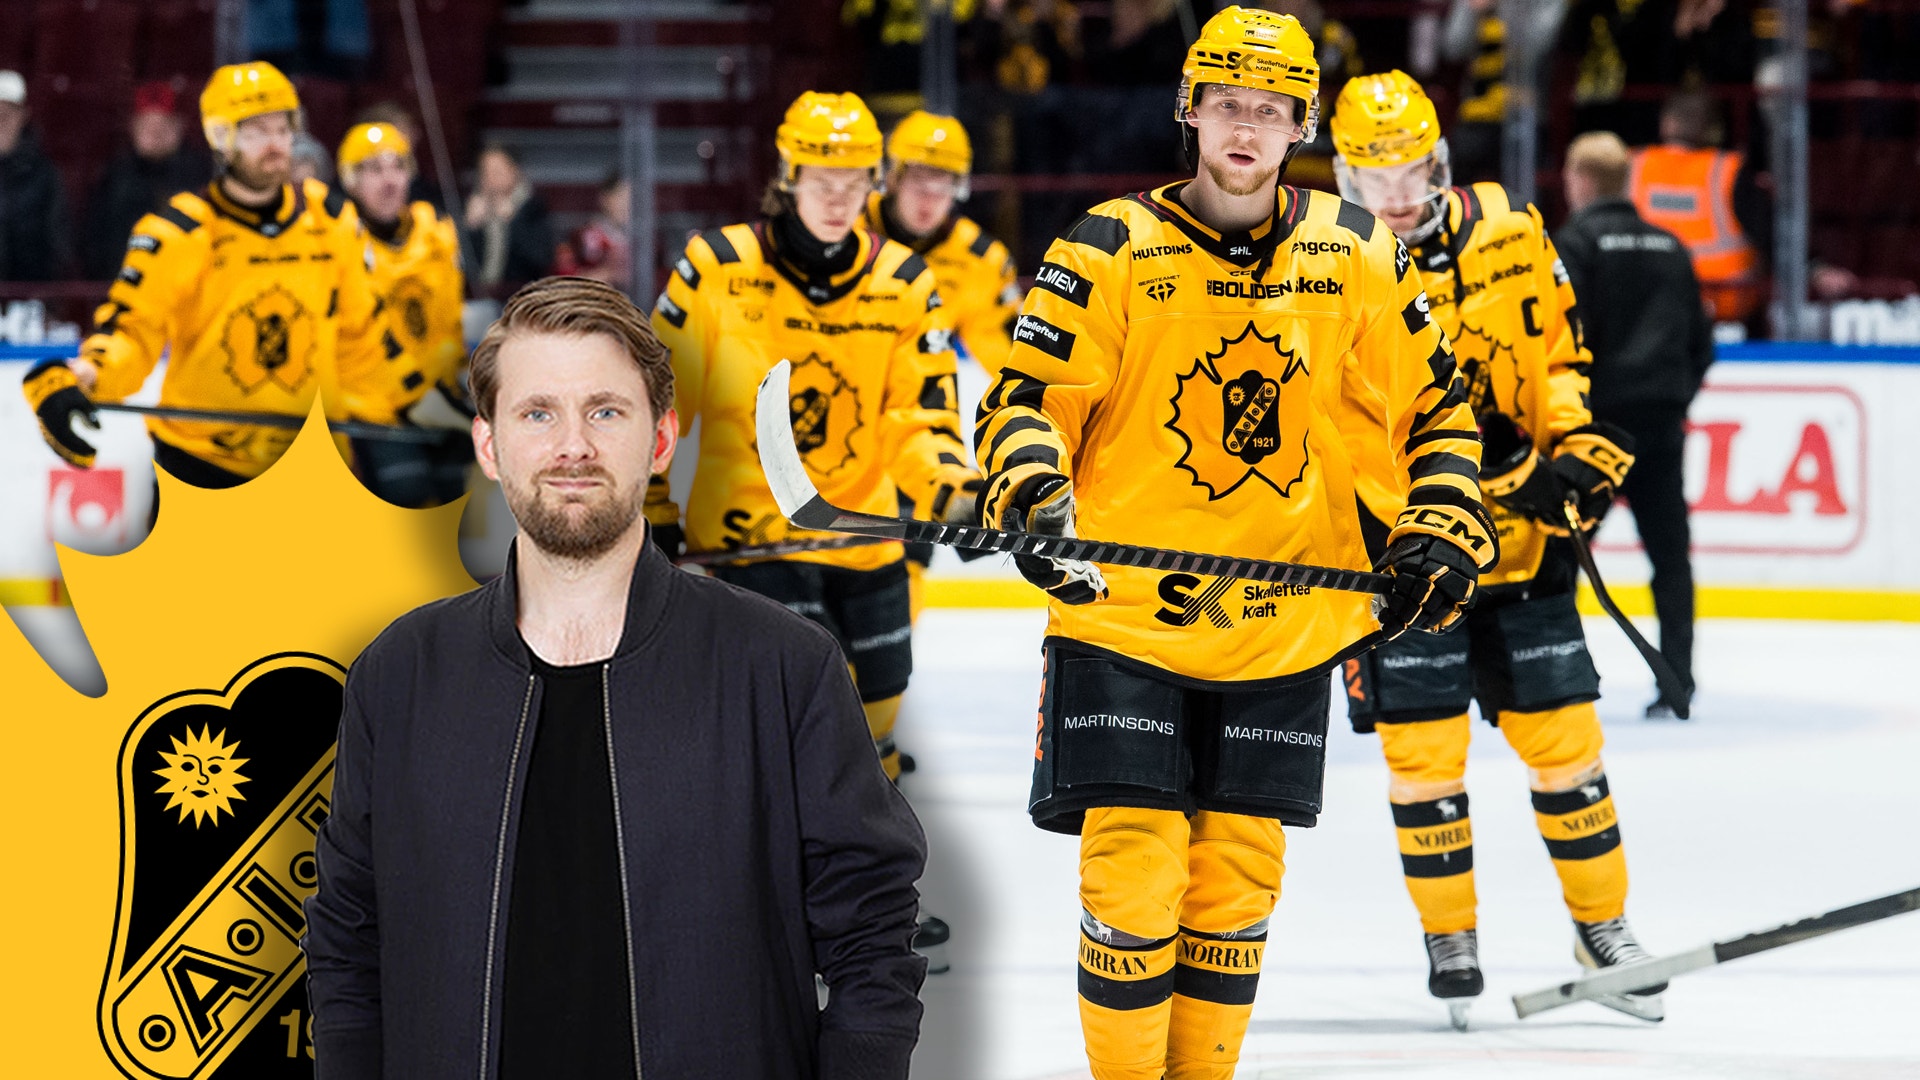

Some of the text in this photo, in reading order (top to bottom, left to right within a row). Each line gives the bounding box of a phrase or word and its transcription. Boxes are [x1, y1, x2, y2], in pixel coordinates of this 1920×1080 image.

[1132, 243, 1193, 261] HULTDINS
[1229, 246, 1252, 256] SHL
[1138, 274, 1181, 287] BERGTEAMET
[1212, 280, 1294, 300] BOLIDEN
[1521, 295, 1544, 337] C
[1252, 436, 1274, 448] 1921
[1395, 508, 1488, 552] CCM
[1154, 572, 1235, 629] SK
[1242, 601, 1278, 620] Kraft
[1064, 714, 1174, 735] MARTINSONS
[1225, 725, 1323, 748] MARTINSONS
[1178, 939, 1262, 968] NORRAN
